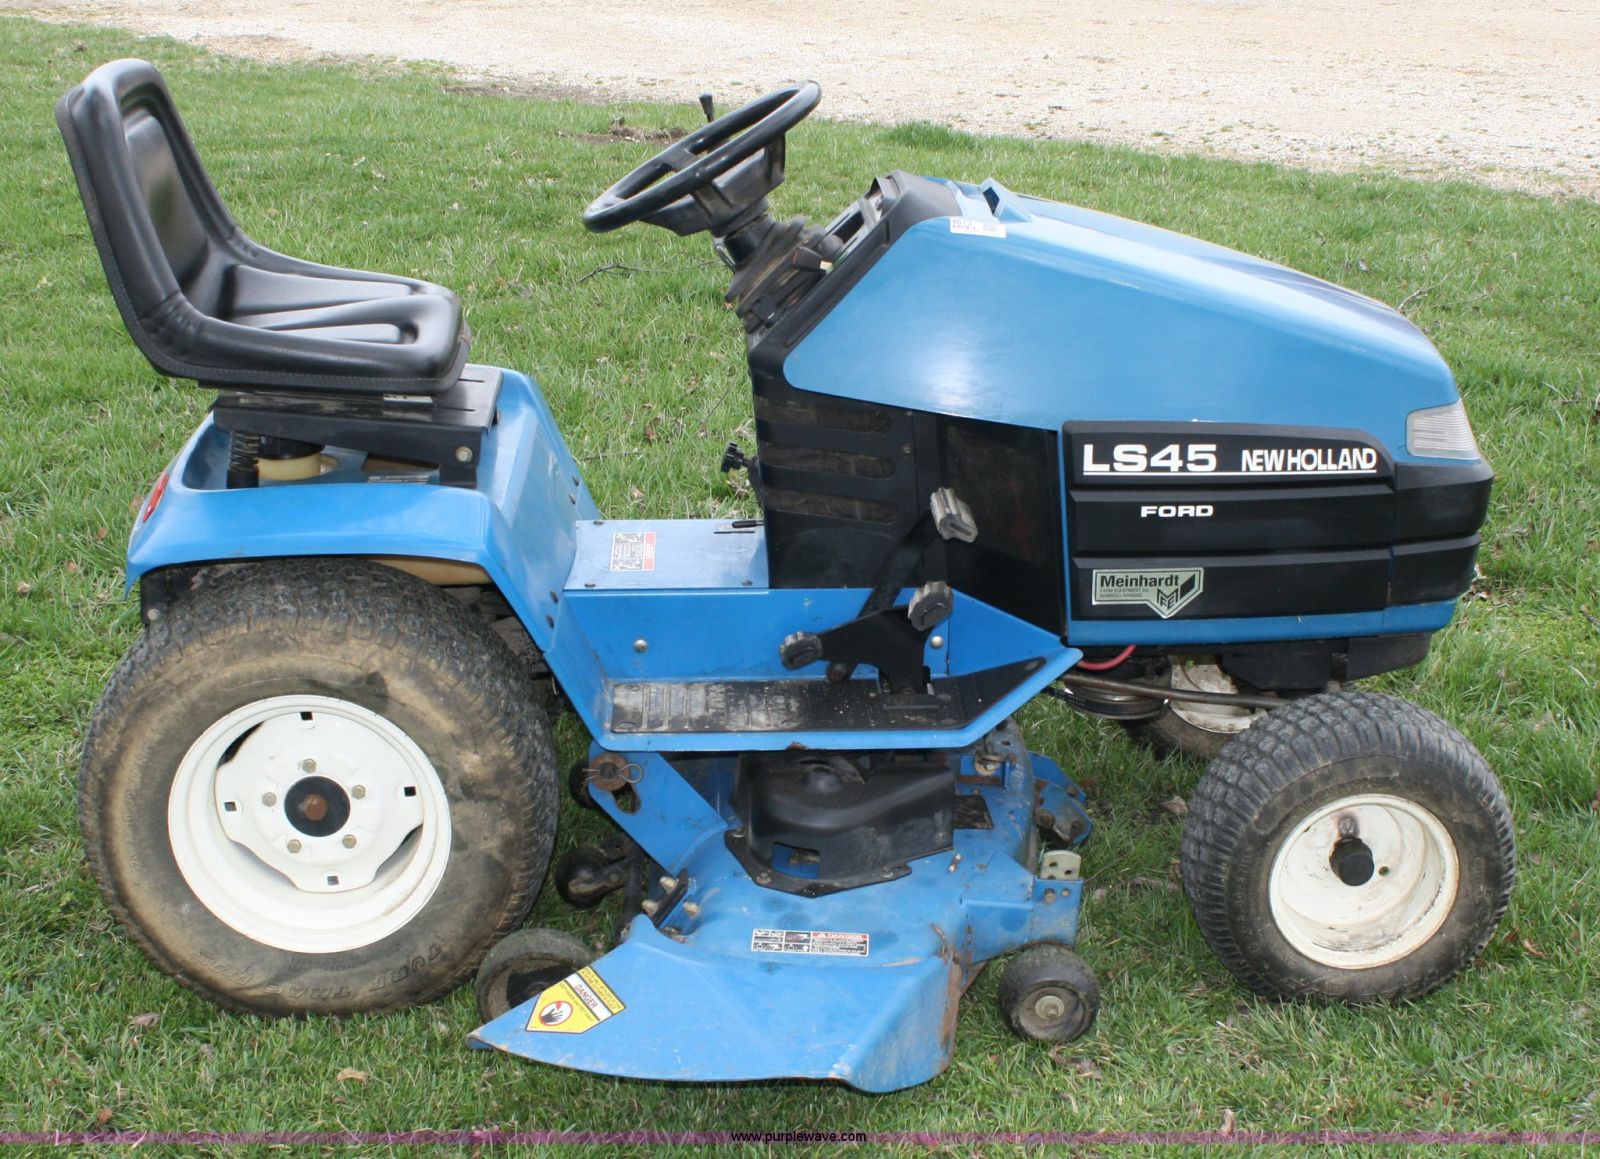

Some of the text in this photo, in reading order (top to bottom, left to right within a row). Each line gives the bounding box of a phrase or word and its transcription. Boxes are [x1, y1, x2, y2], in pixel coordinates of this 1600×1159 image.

[1083, 444, 1377, 472] LS45 NEW HOLLAND
[1140, 505, 1214, 518] FORD
[1100, 574, 1180, 587] Meinhardt
[574, 983, 598, 1009] DANGER
